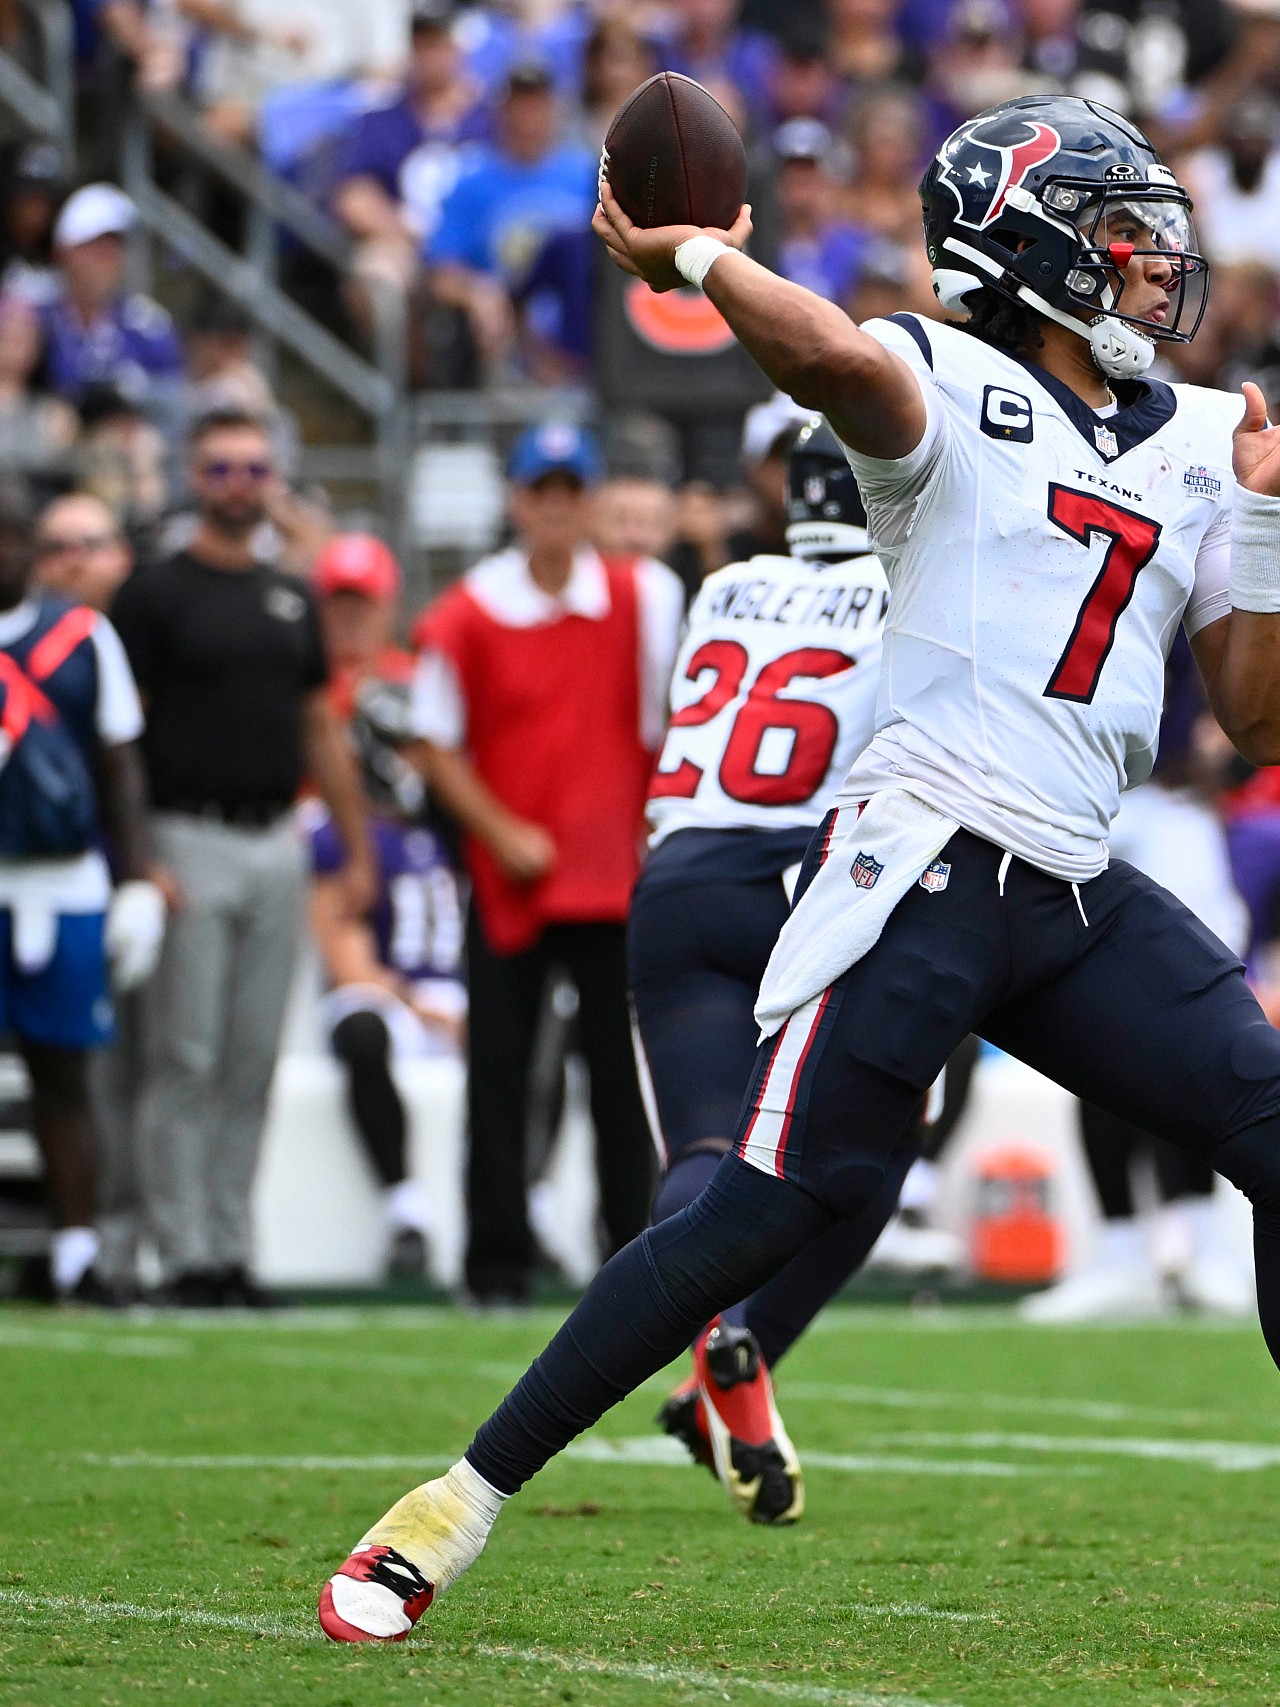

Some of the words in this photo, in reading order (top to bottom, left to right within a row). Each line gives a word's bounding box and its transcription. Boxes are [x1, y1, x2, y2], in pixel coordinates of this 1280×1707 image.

[986, 389, 1030, 429] C
[1073, 469, 1143, 502] TEXANS
[1042, 482, 1163, 705] 7
[650, 640, 856, 806] 26
[851, 863, 874, 887] NFL
[923, 871, 943, 887] NFL
